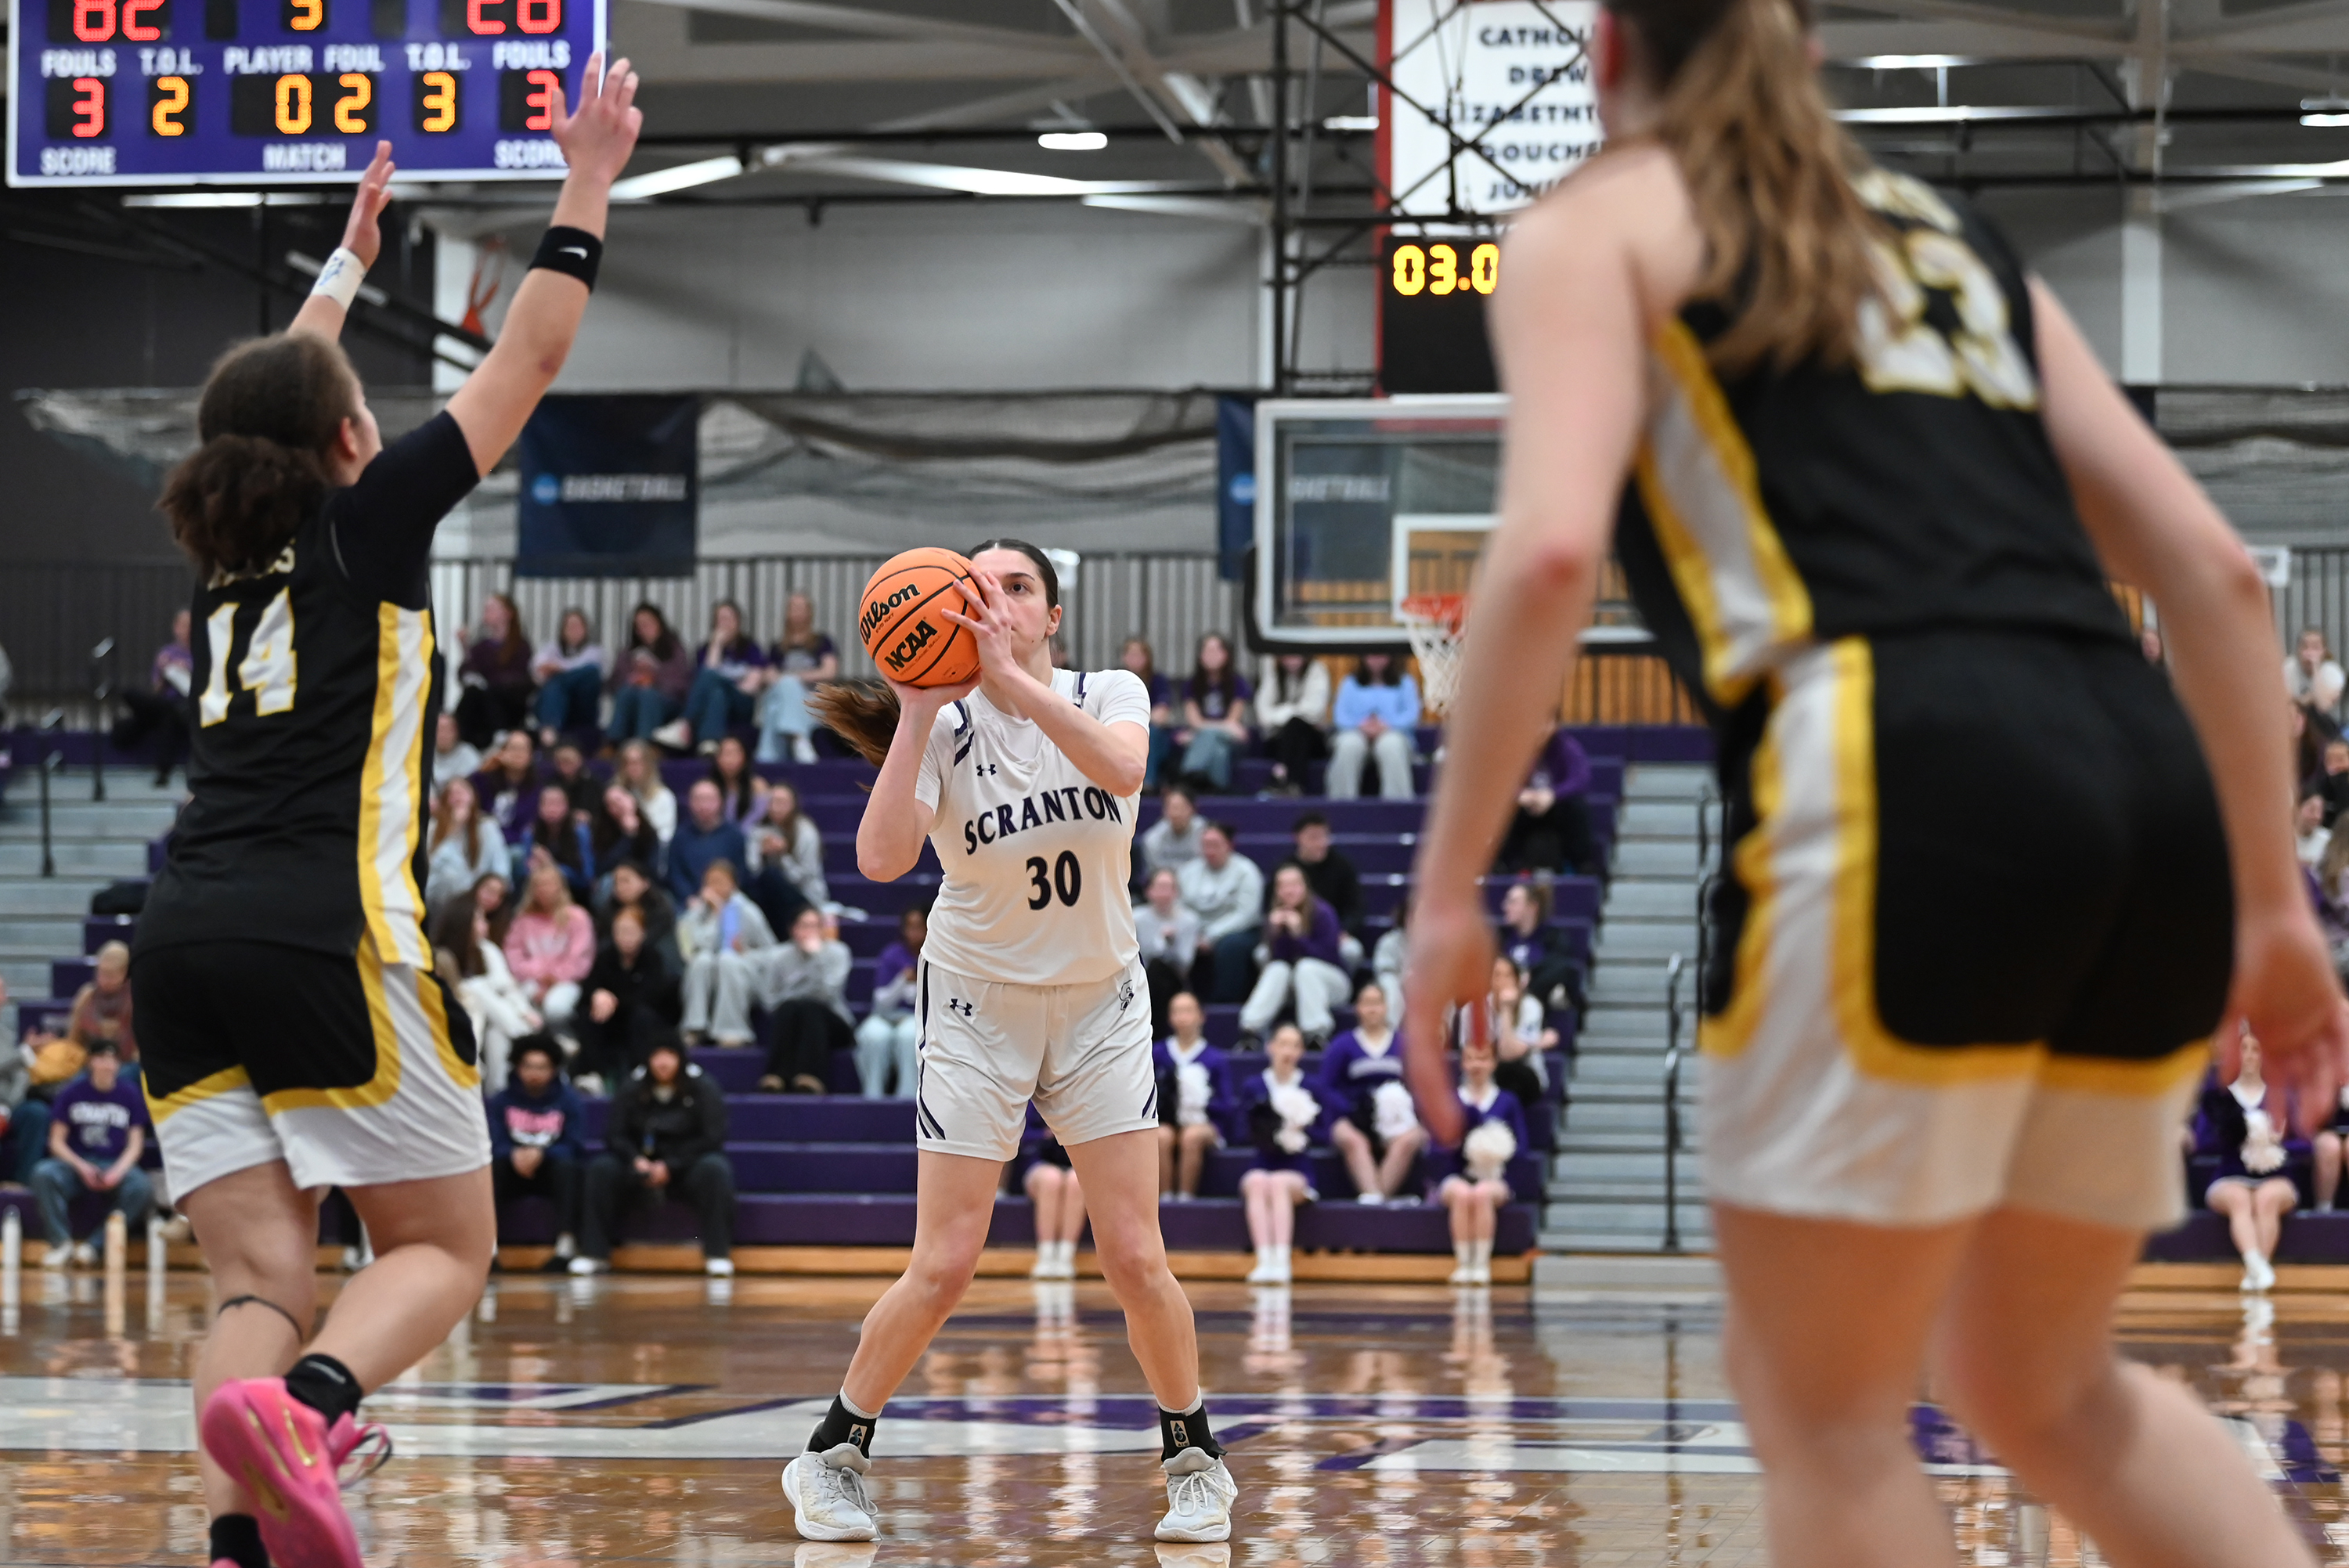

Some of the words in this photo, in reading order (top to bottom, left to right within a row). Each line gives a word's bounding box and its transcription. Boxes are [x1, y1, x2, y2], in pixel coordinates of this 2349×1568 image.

[41, 49, 117, 77] FOULS
[138, 47, 204, 76] T.O.L.
[223, 45, 313, 74] PLAYER
[405, 41, 471, 71] T.O.L.
[493, 40, 571, 70] FOULS
[73, 77, 105, 137] 3
[152, 76, 189, 136] 2
[423, 71, 455, 132] 3
[525, 70, 558, 130] 3
[41, 146, 117, 176] SCORE
[262, 143, 346, 172] MATCH
[1392, 243, 1499, 296] 03.0
[860, 584, 920, 645] Wilson
[199, 586, 298, 729] 14
[884, 620, 937, 672] NCAA
[965, 787, 1123, 856] SCRANTON
[1026, 850, 1081, 910] 30
